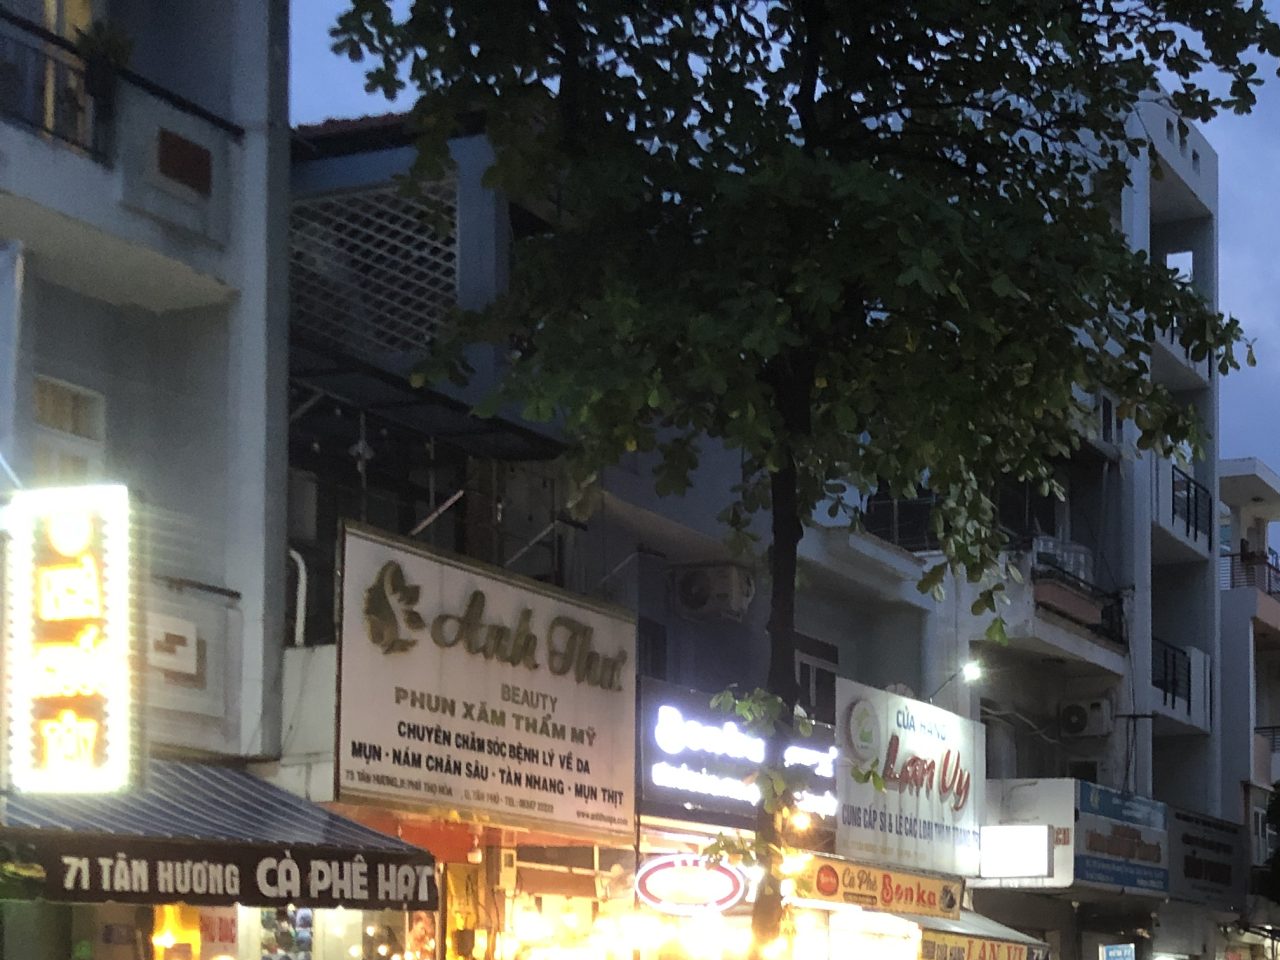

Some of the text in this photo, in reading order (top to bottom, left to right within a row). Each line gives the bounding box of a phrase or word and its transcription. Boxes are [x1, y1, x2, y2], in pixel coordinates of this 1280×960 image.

[430, 590, 540, 671] Anh
[394, 686, 456, 717] PHUN
[501, 683, 558, 713] BEAUTY
[398, 721, 451, 746] CHUYÊN
[486, 737, 507, 759] SÓC
[508, 742, 539, 765] BỆNH
[576, 759, 591, 775] DA
[351, 741, 382, 765] MỤN
[499, 765, 522, 787] TÀN
[525, 772, 564, 795] NHANG
[574, 783, 598, 804] MỤN
[600, 787, 624, 808] THỊT
[61, 854, 91, 890] 71
[98, 852, 149, 892] TÂN
[157, 859, 240, 896] HƯƠNG
[256, 850, 300, 898] CÀ
[310, 854, 368, 900] PHÊ
[880, 871, 937, 907] Bonka
